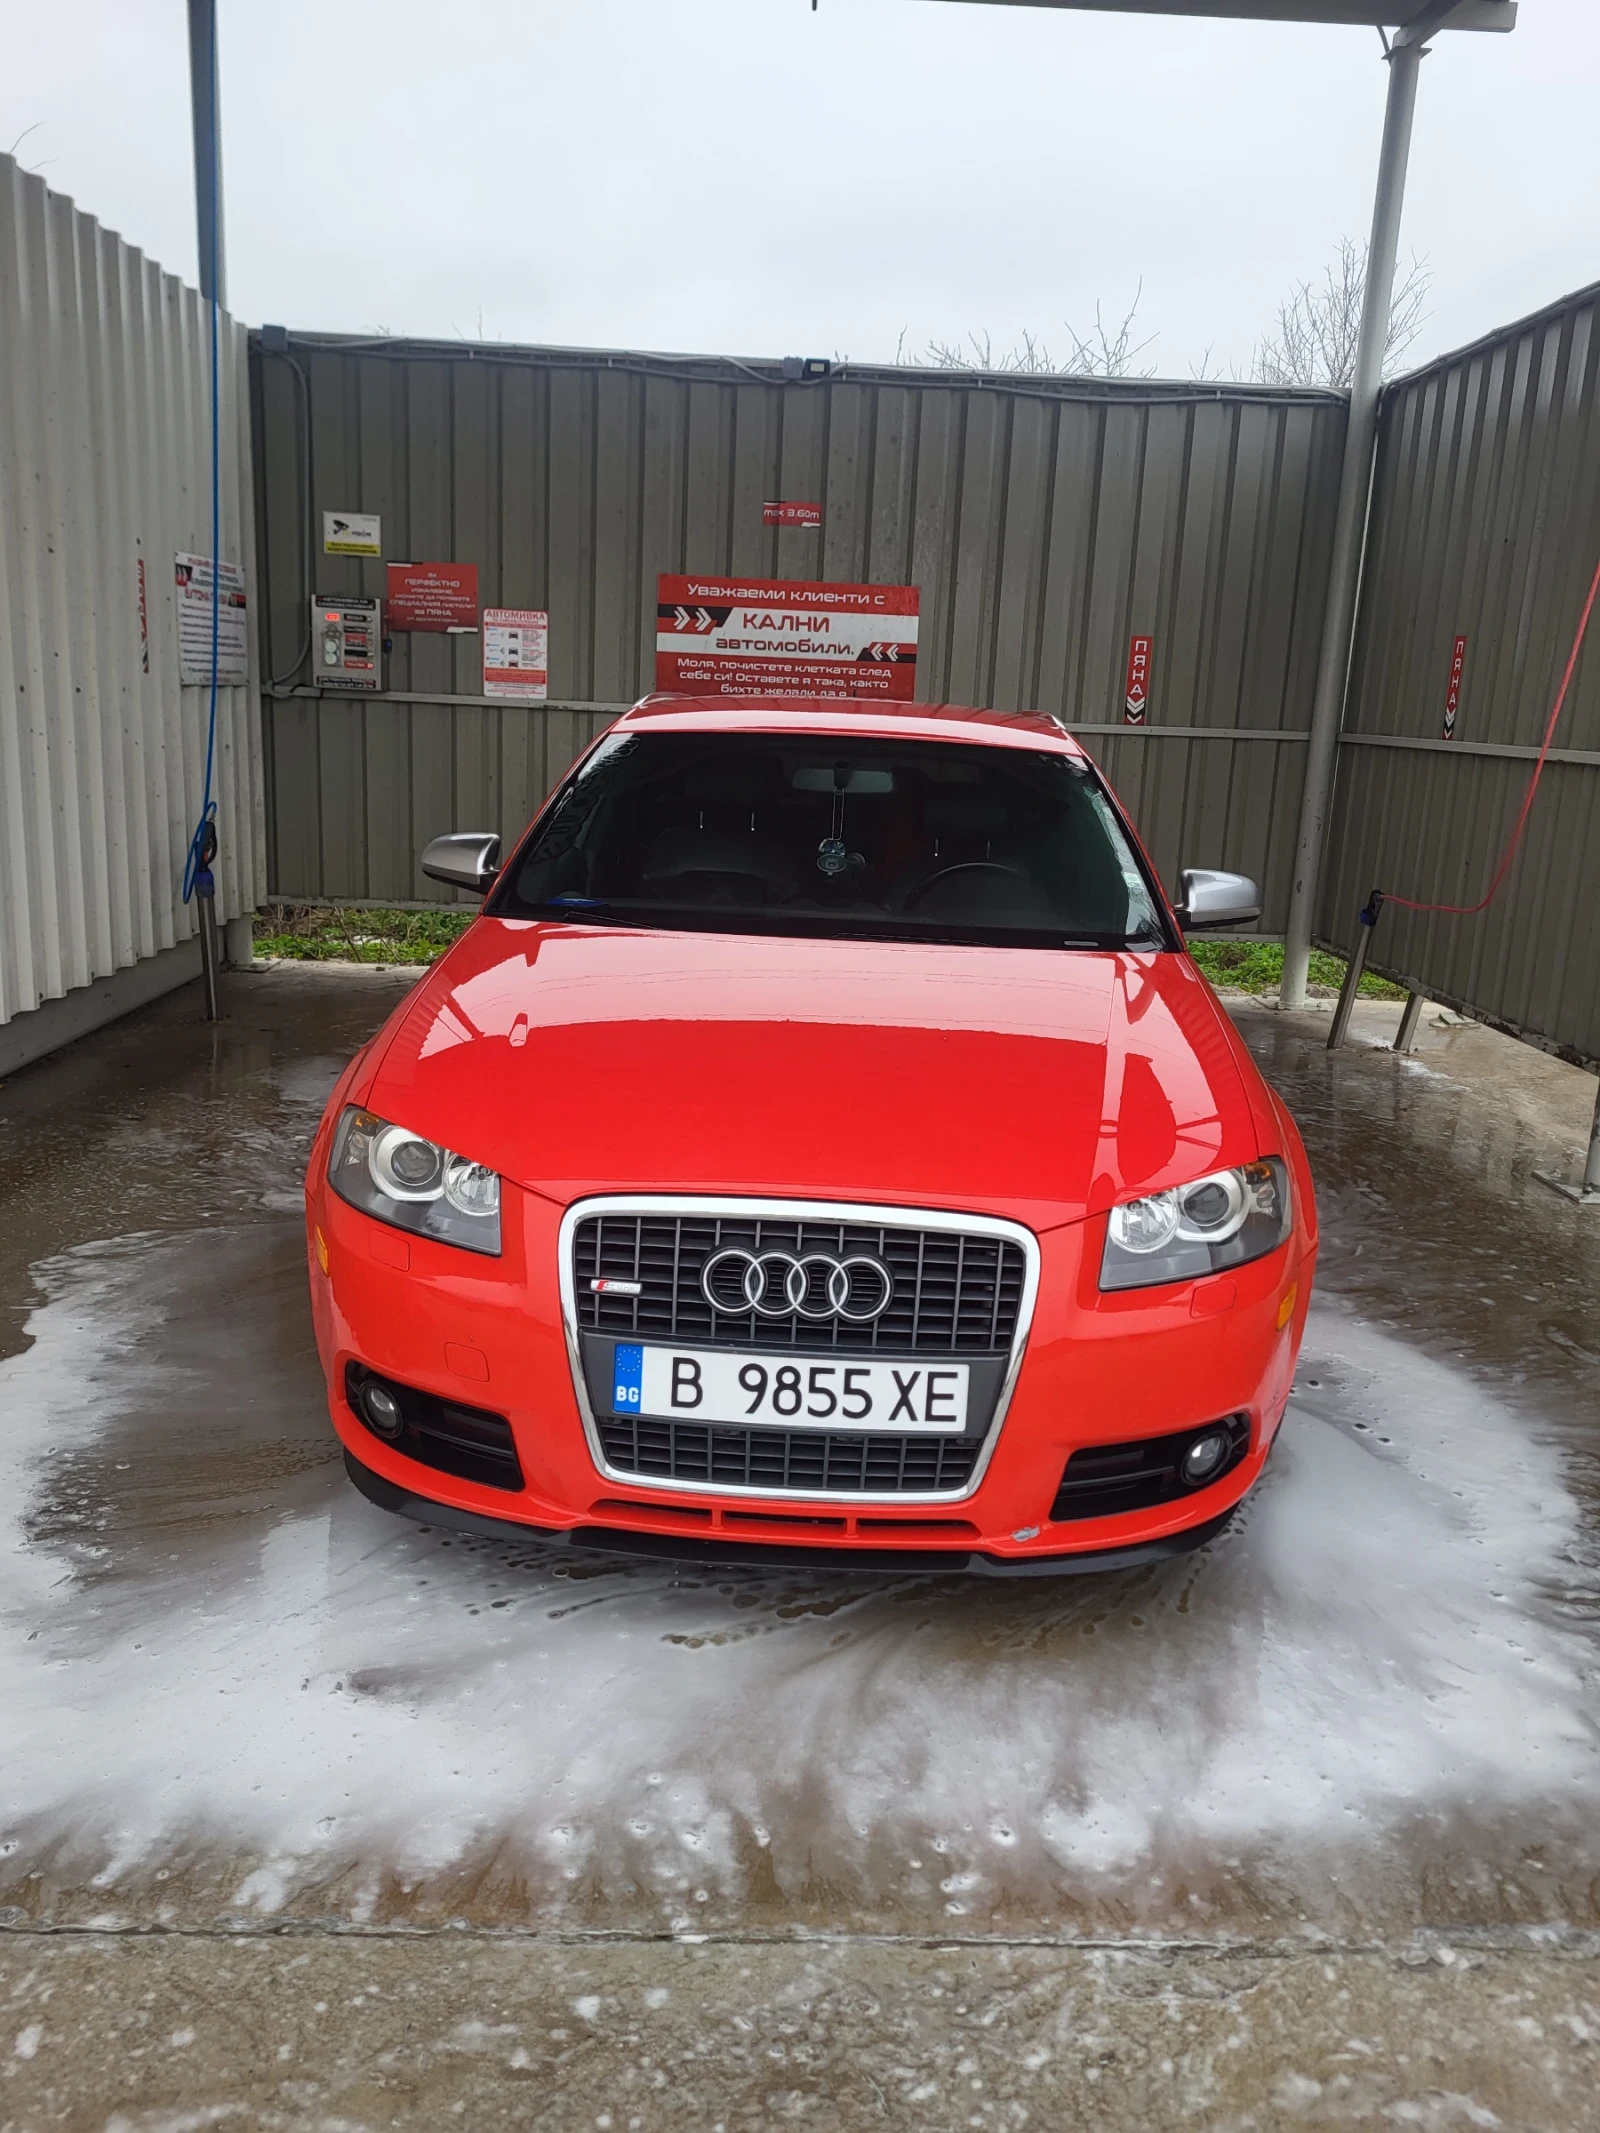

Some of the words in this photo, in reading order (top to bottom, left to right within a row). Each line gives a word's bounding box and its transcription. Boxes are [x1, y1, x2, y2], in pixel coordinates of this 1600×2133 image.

[404, 578, 460, 588] ПЕРФЕКТНО
[687, 583, 786, 600] Уважаеми
[790, 588, 870, 604] клиенти
[874, 595, 885, 605] с
[486, 609, 546, 621] АВТОМИВКА
[743, 613, 830, 633] КАЛНИ
[715, 637, 855, 656] автомобили.
[677, 658, 717, 669] Моля,
[719, 661, 792, 672] почистете
[795, 665, 857, 675] клетката
[859, 667, 892, 678] след
[1129, 640, 1148, 696] ПЯНА
[1448, 641, 1464, 705] ПЯНА
[679, 670, 711, 680] себе
[713, 672, 733, 681] си!
[735, 673, 800, 684] Оставете
[802, 677, 811, 685] я
[813, 677, 847, 688] така,
[849, 679, 889, 689] както
[720, 683, 762, 695] бихте
[615, 1385, 640, 1404] BG
[670, 1356, 704, 1409] B
[738, 1362, 873, 1419] 9855
[887, 1369, 959, 1423] XE
